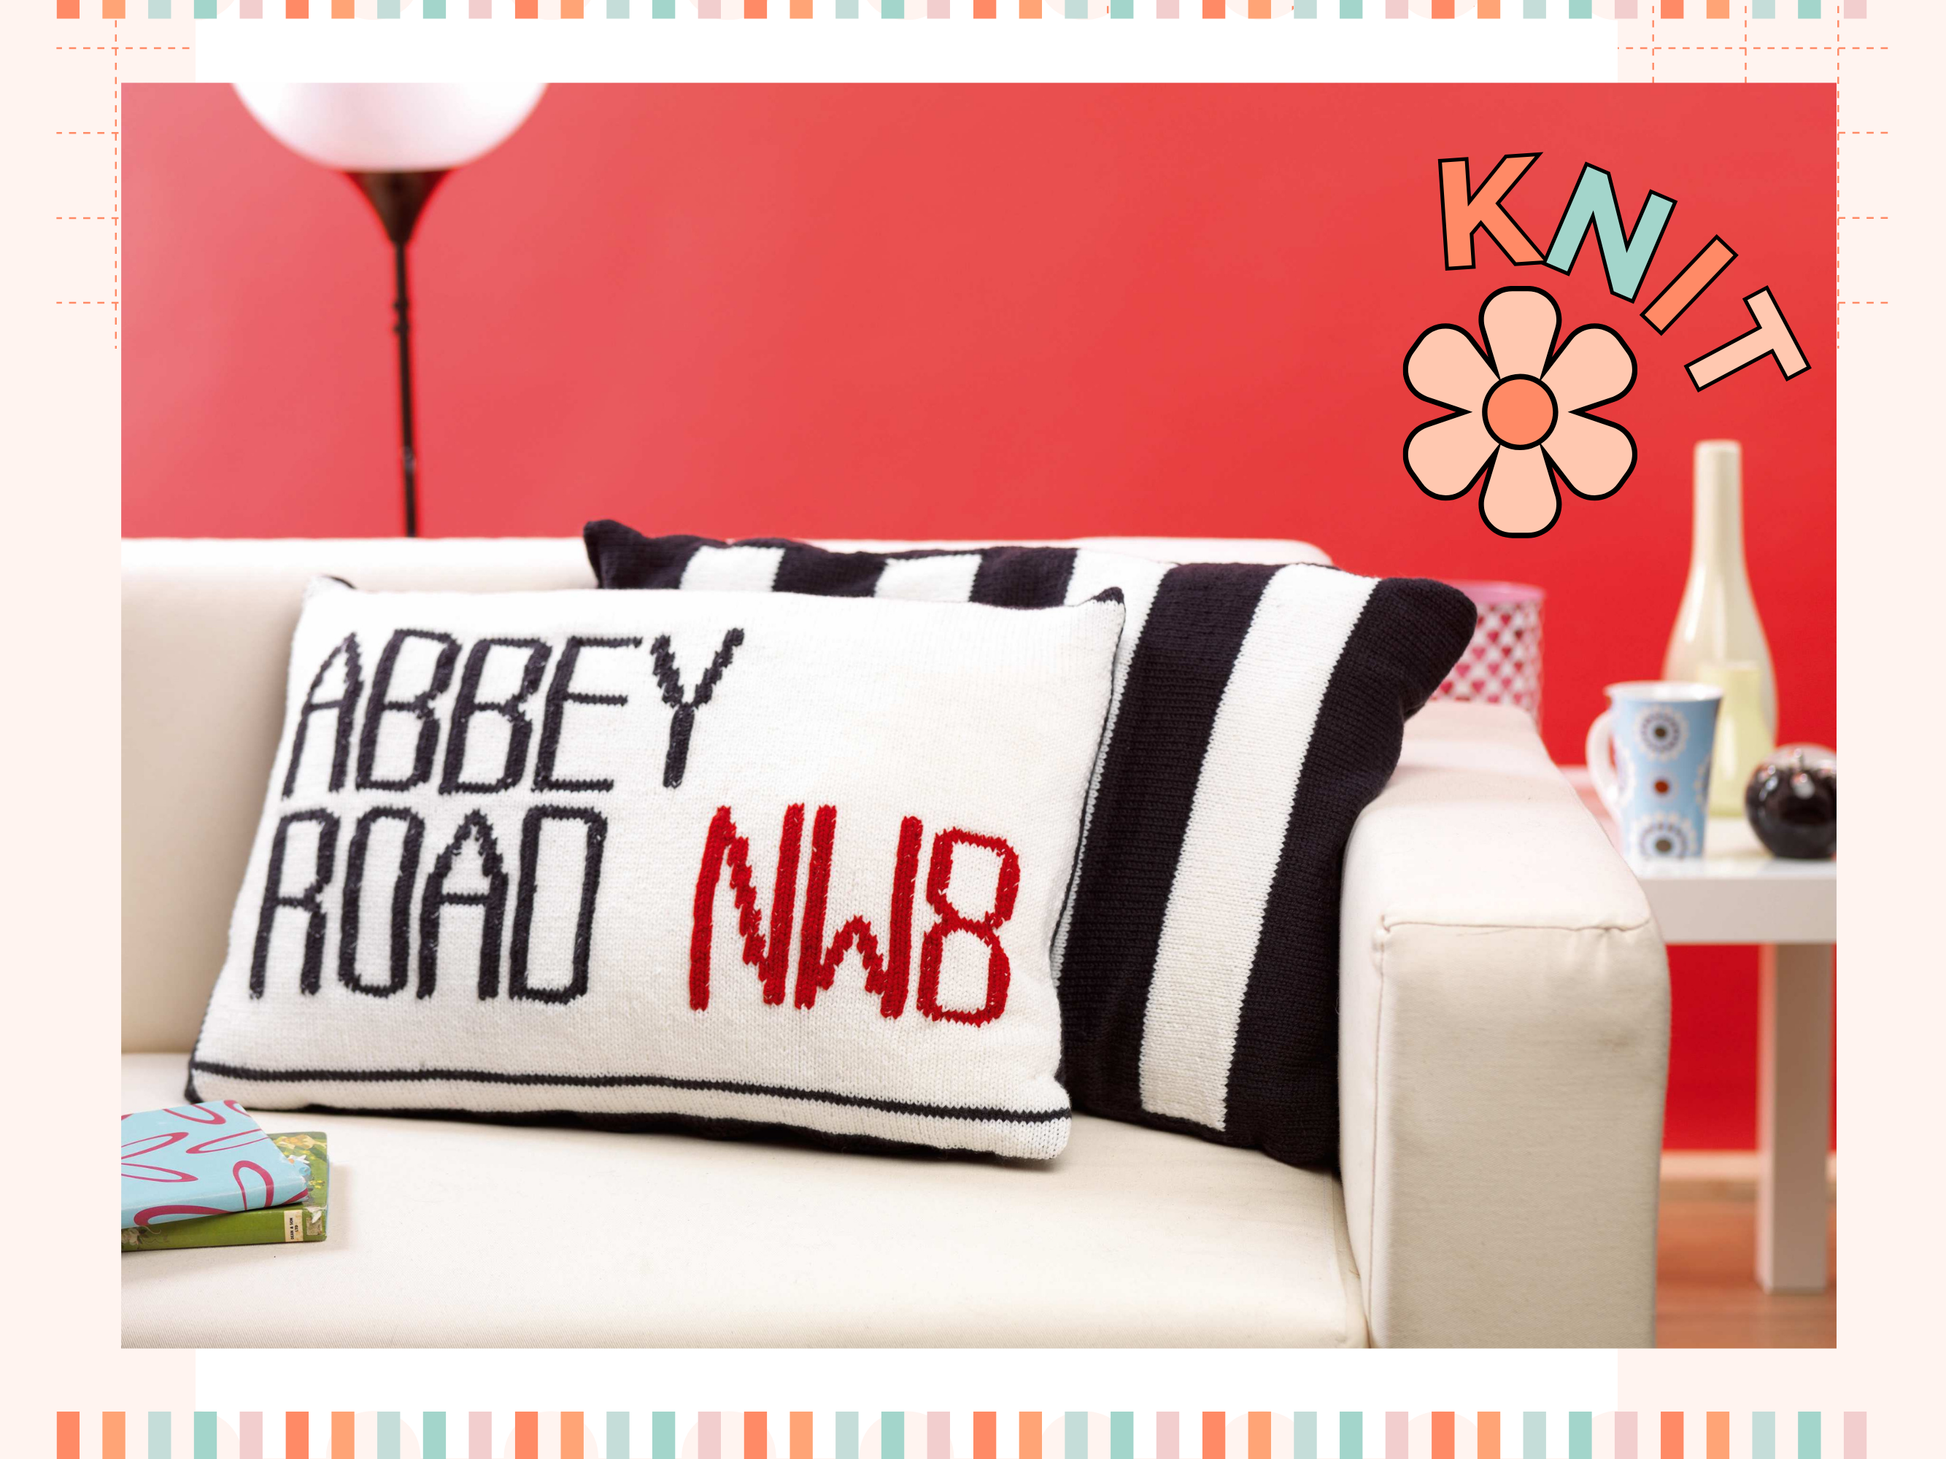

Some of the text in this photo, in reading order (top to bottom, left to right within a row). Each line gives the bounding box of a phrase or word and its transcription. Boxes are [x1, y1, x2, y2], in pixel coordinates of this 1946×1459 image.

[282, 628, 744, 798] ABBEY
[249, 803, 1020, 1028] ROAD NW8
